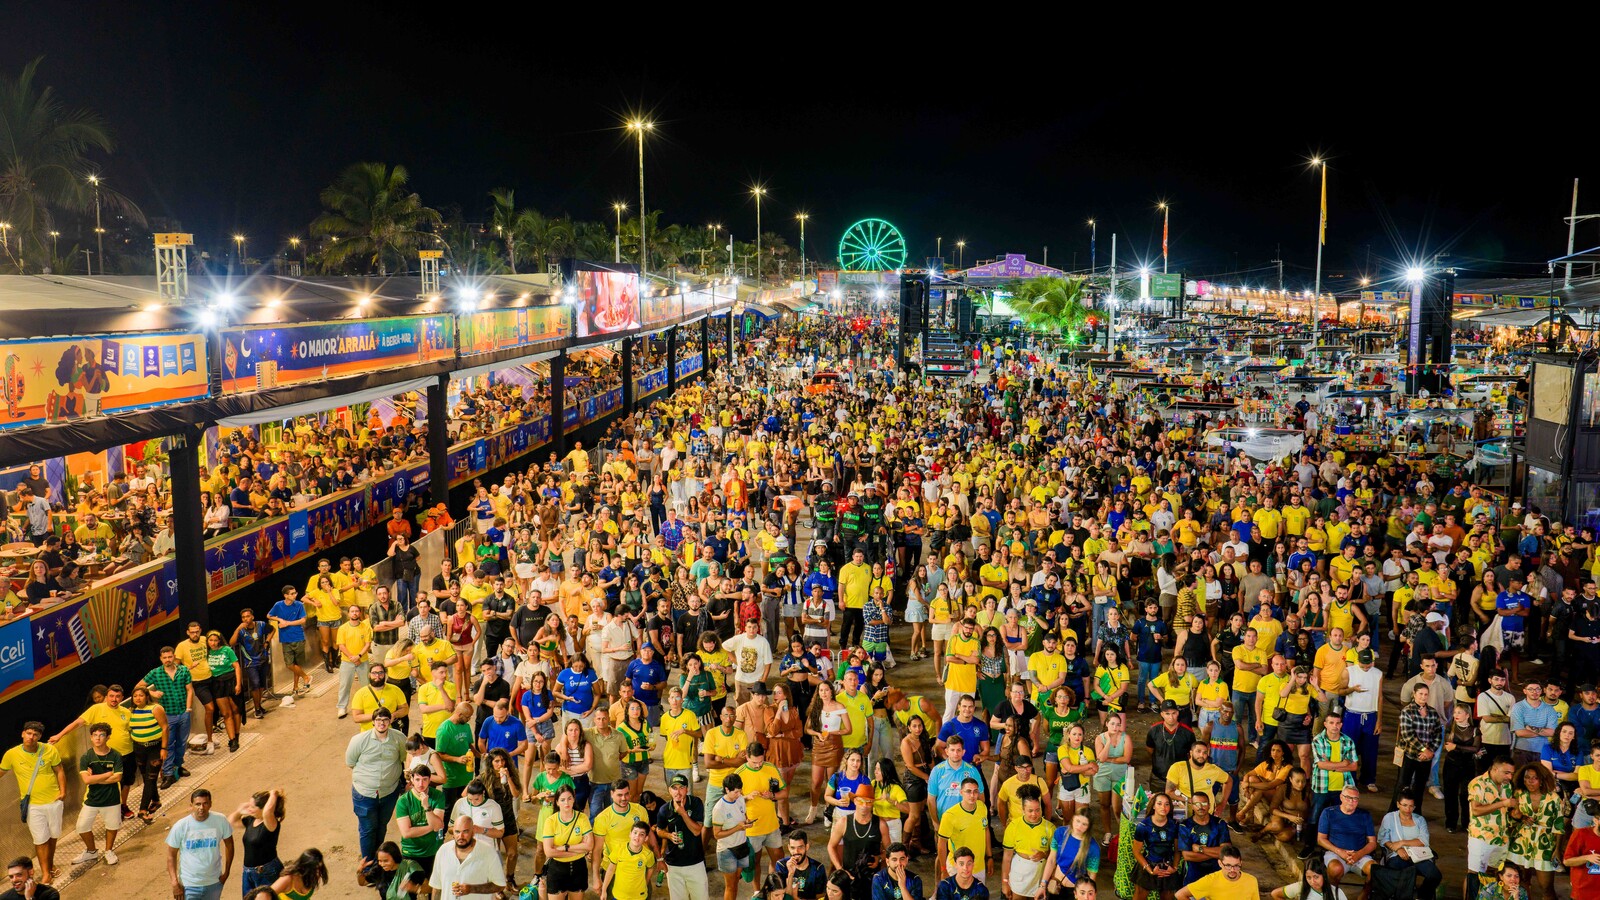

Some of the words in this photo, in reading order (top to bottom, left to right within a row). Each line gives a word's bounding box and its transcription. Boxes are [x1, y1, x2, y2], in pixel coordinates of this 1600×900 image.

[299, 341, 307, 359] O
[308, 338, 337, 358] MAIOR
[338, 331, 376, 354] ARRAIÁ
[386, 333, 412, 347] BEIRA-MAR
[0, 638, 25, 664] Celi
